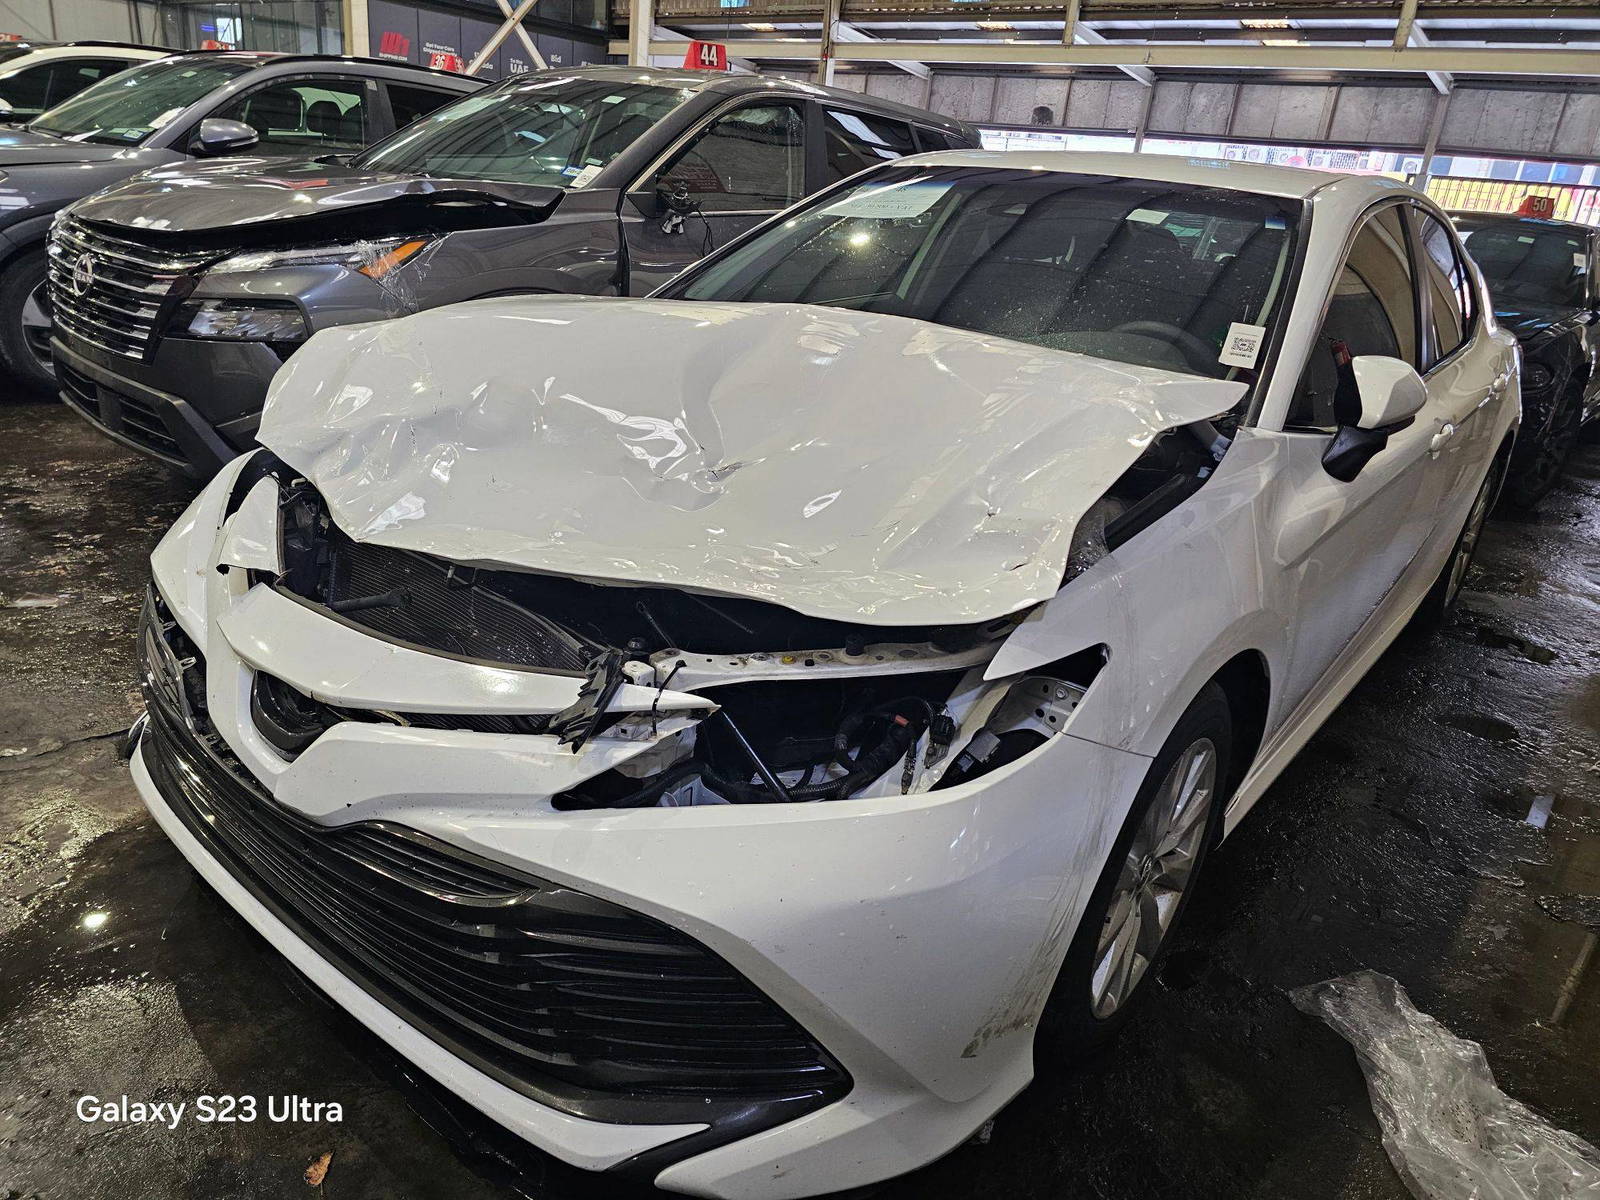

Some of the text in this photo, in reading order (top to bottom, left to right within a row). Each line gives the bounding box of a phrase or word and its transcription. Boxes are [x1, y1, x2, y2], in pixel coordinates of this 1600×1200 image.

[435, 55, 445, 69] 36
[700, 44, 717, 66] 44
[1533, 198, 1548, 212] 50
